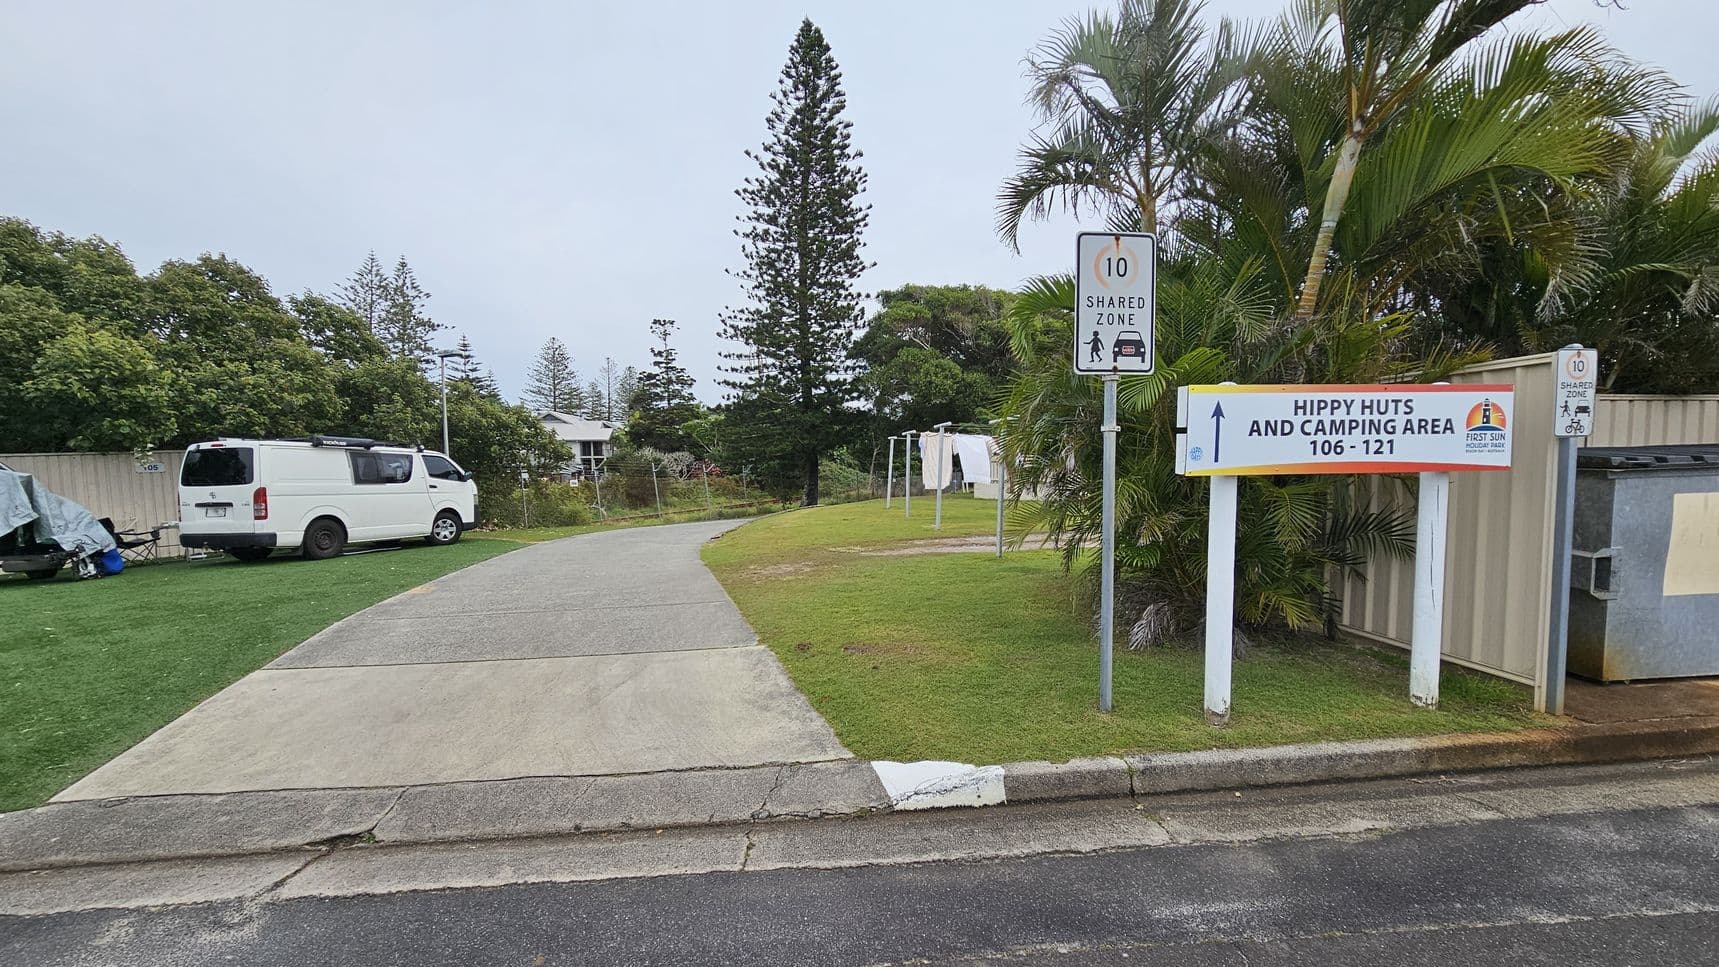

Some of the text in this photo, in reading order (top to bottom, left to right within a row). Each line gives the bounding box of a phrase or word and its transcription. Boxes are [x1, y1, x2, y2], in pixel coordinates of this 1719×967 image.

[1106, 257, 1128, 278] 10
[1086, 295, 1145, 309] SHARED
[1096, 313, 1136, 326] ZONE
[1573, 360, 1585, 372] 10
[1560, 381, 1593, 390] SHARED
[1566, 390, 1587, 398] ZONE
[1293, 398, 1414, 416] HIPPY HUTS
[1248, 418, 1456, 437] AND CAMPING AREA
[1466, 432, 1506, 442] FIRST SUN
[1309, 439, 1344, 456] 106
[1362, 439, 1395, 455] 121
